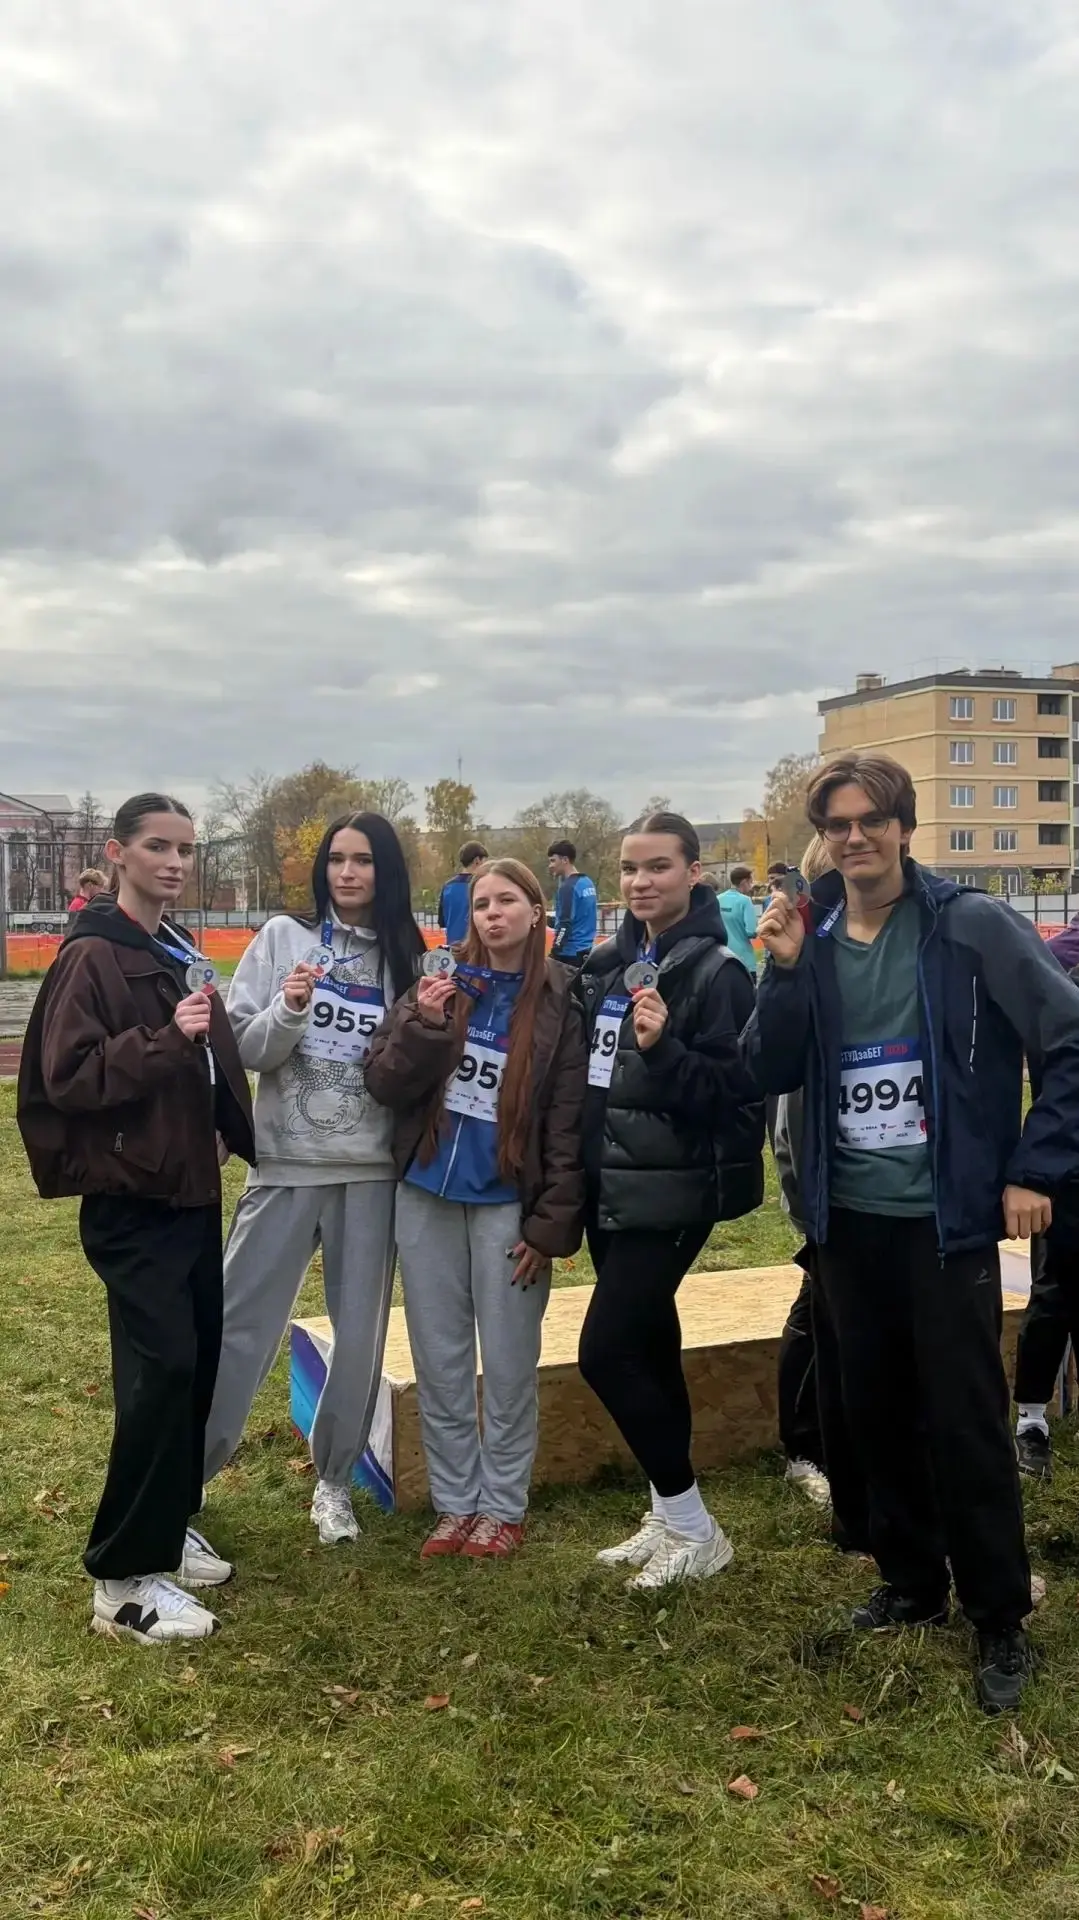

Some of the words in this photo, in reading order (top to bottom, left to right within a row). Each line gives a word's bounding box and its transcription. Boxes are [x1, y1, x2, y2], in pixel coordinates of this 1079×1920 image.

[312, 1001, 377, 1037] 955
[456, 1054, 504, 1092] 95
[838, 1075, 924, 1115] 4994
